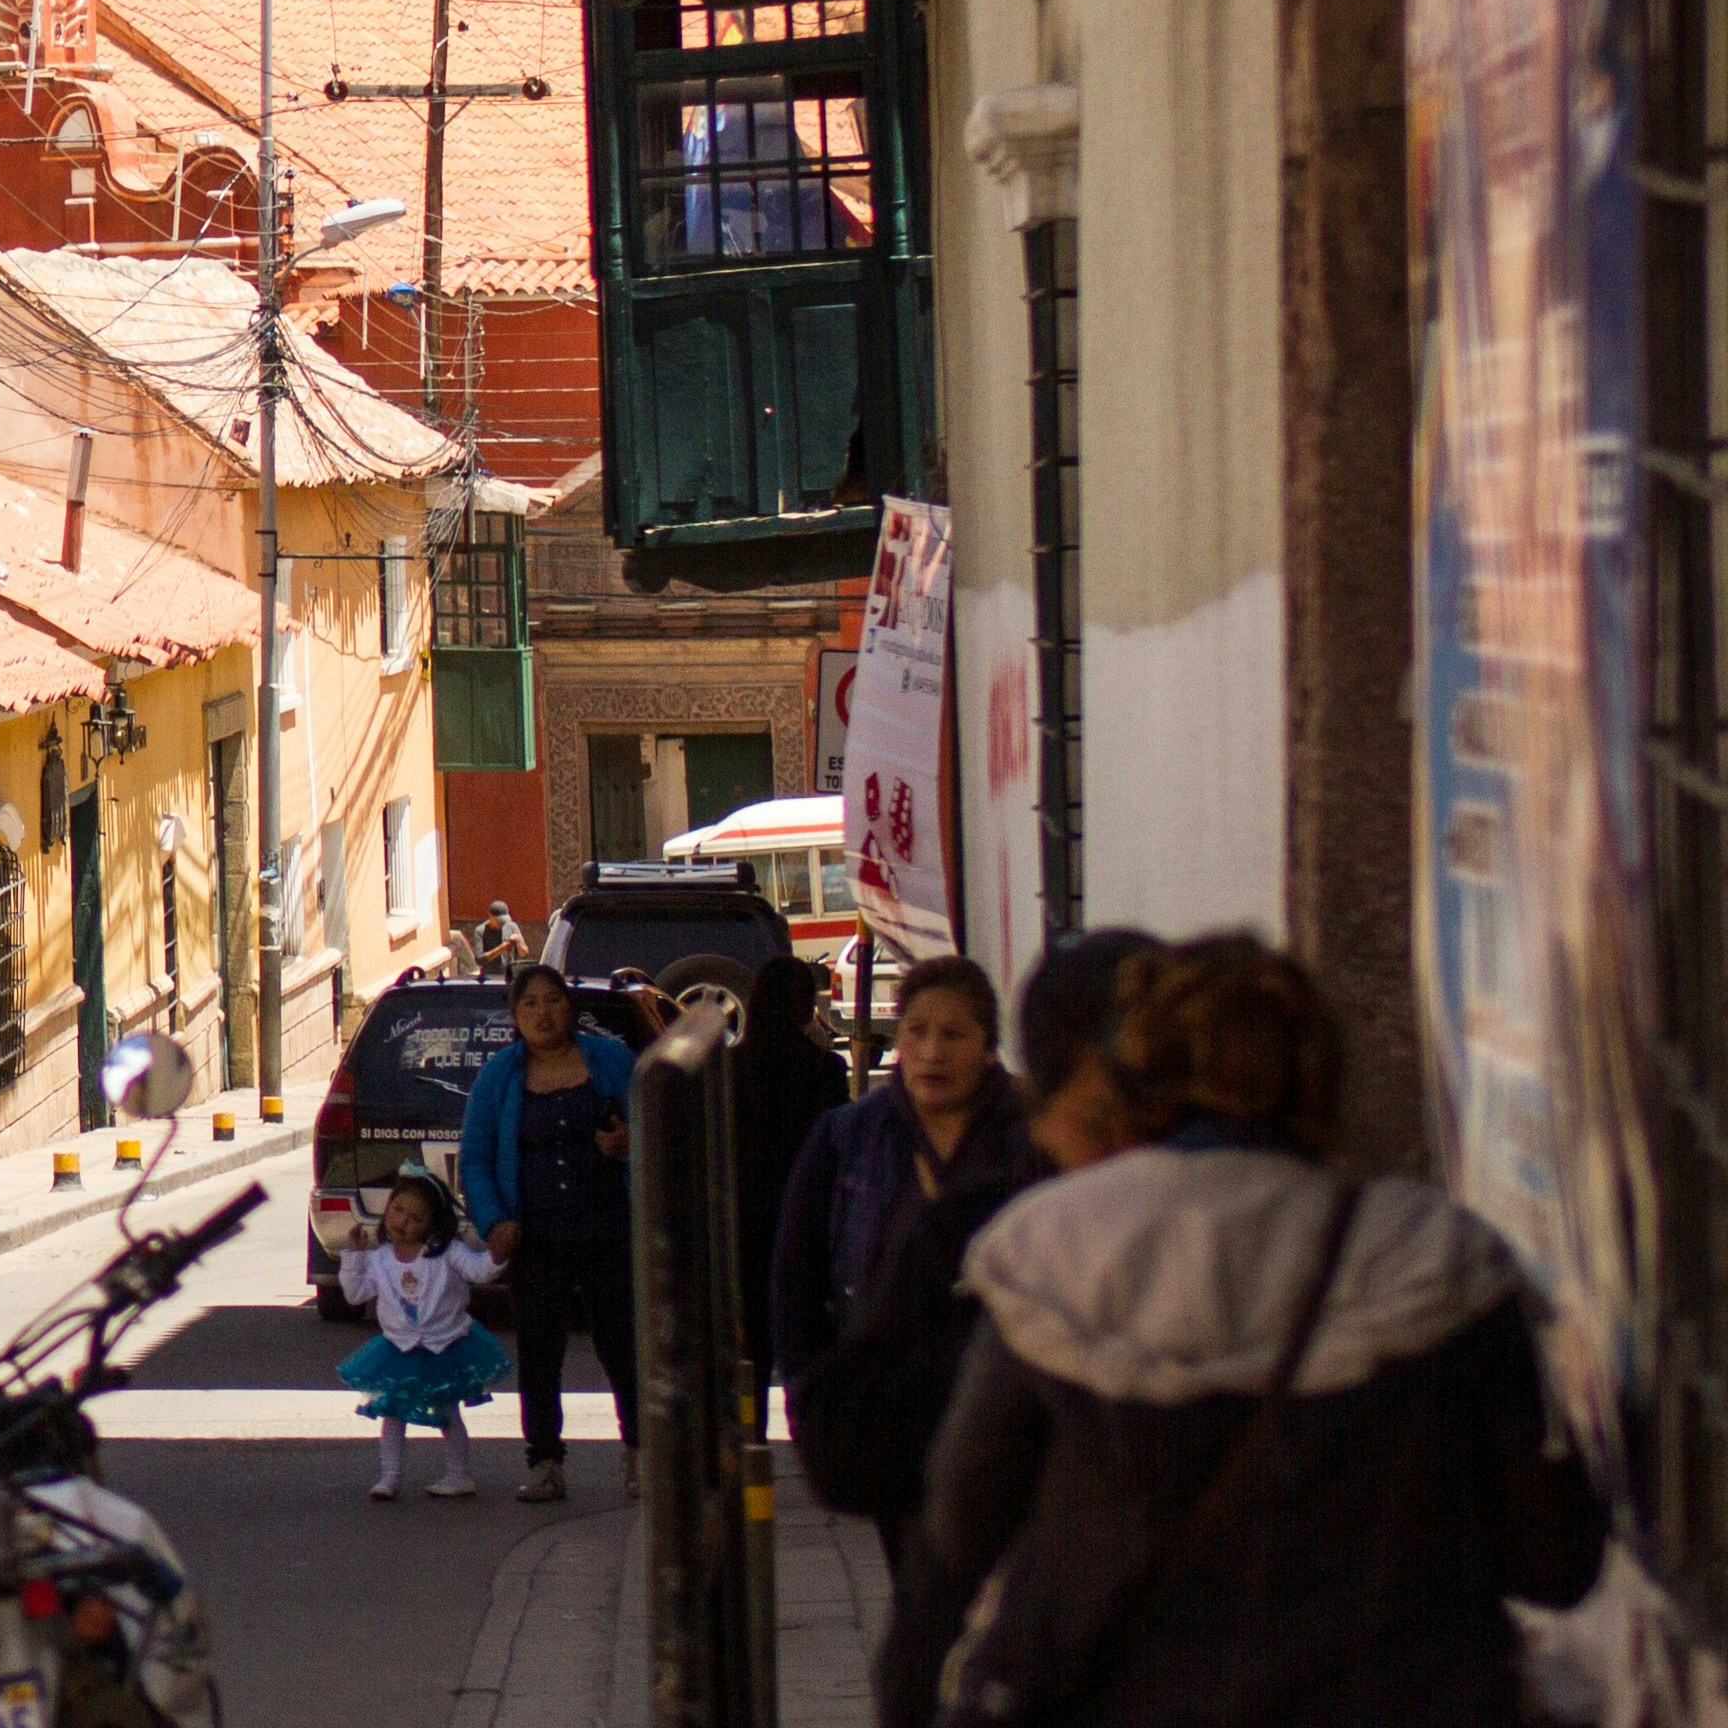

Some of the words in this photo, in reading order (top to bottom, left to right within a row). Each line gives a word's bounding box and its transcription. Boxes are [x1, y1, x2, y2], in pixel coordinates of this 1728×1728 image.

[434, 1051, 461, 1068] QUE
[464, 1051, 483, 1067] ME
[360, 1128, 372, 1139] SI
[374, 1128, 400, 1139] DIOS
[402, 1129, 426, 1139] CON
